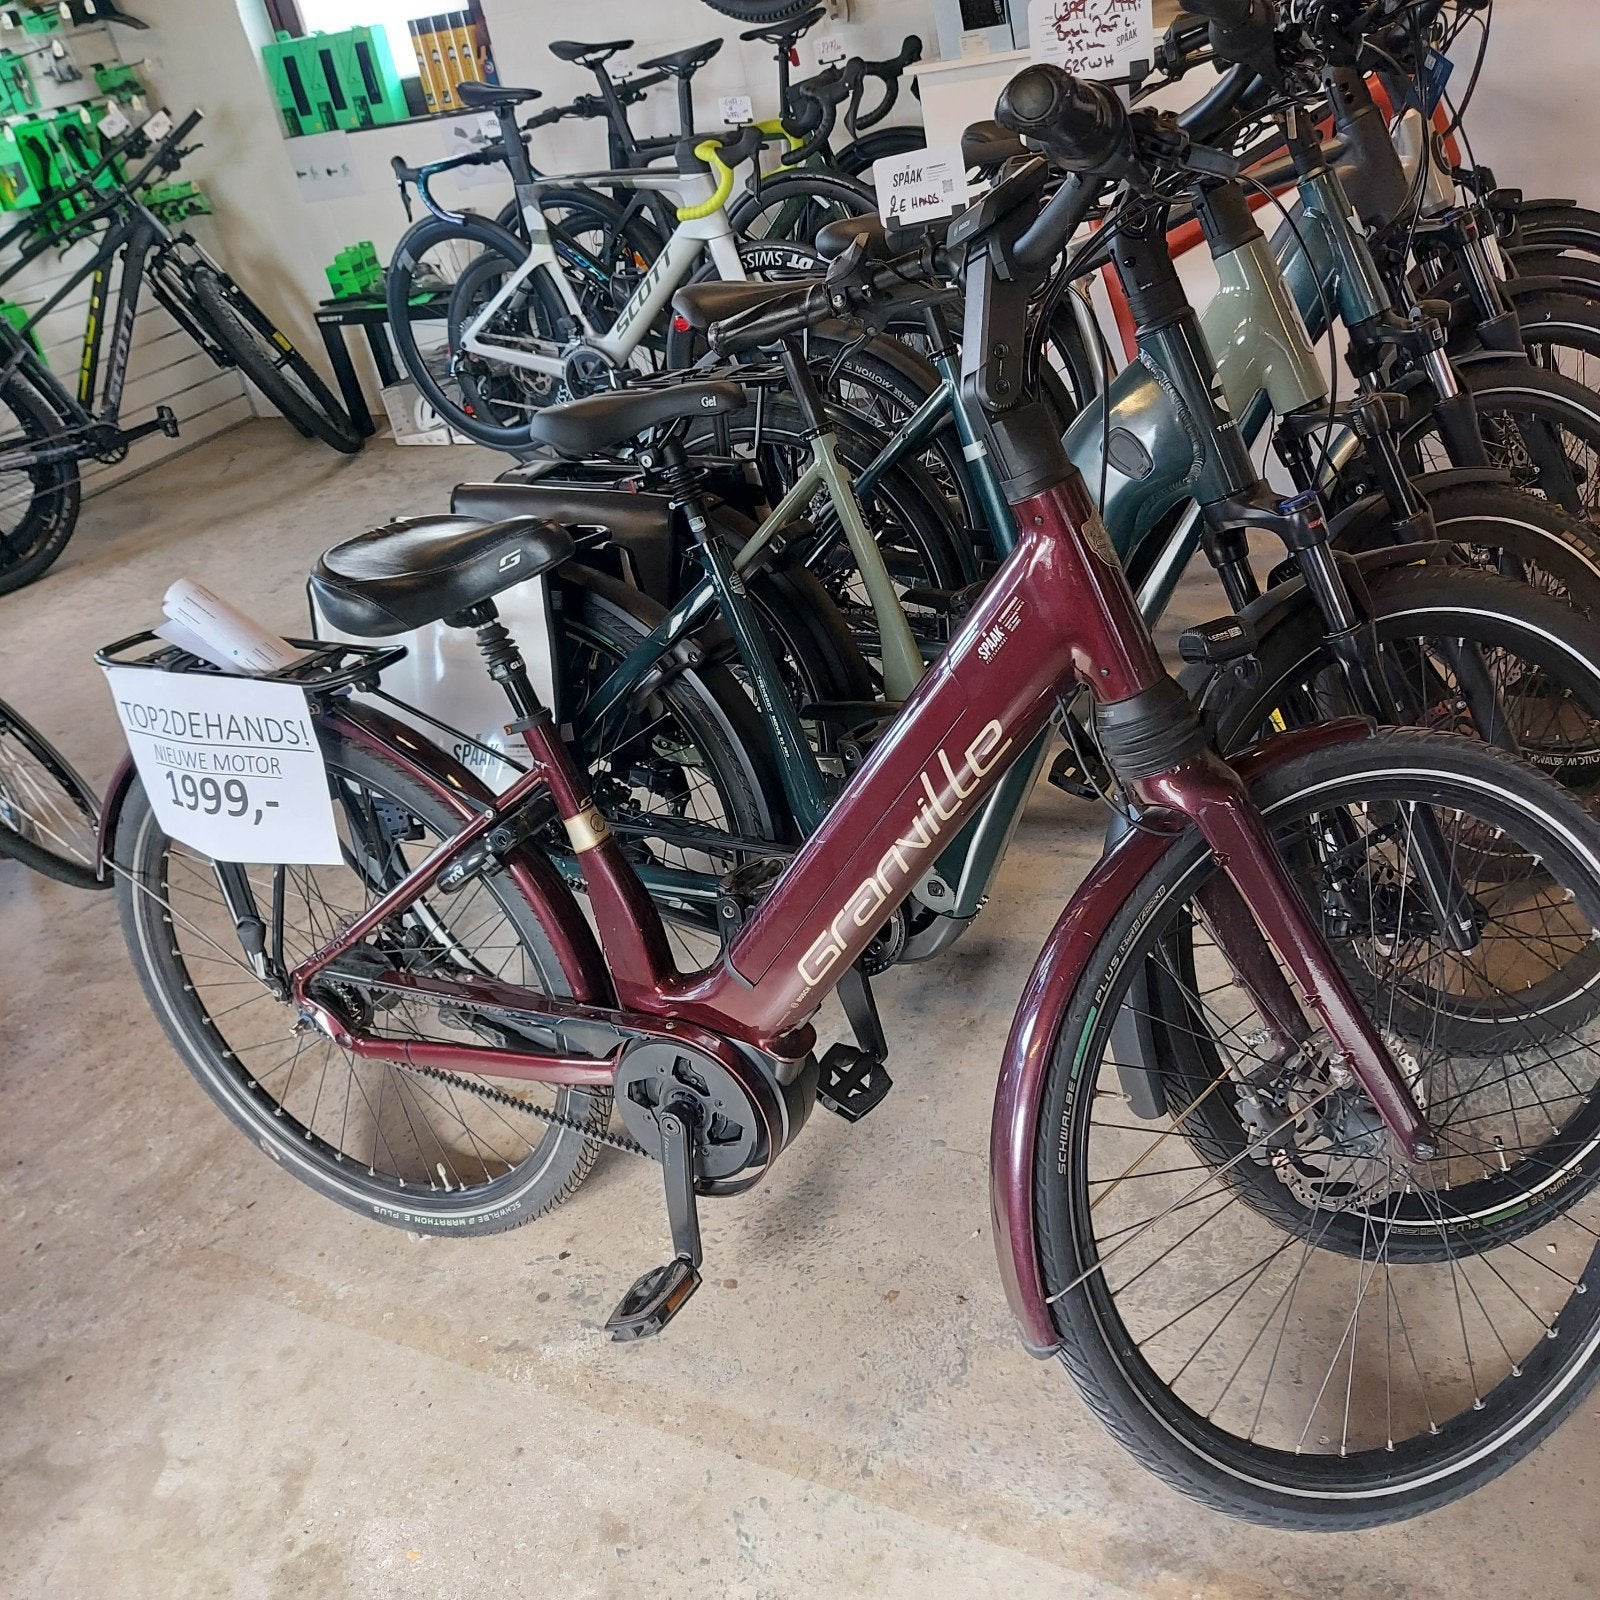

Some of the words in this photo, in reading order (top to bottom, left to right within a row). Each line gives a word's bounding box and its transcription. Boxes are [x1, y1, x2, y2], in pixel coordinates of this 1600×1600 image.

[786, 254, 815, 270] DT
[616, 243, 672, 340] SCOTT
[854, 365, 893, 389] MOTION
[701, 395, 717, 407] Gel
[120, 701, 310, 746] TOP2DEHANDS!
[154, 744, 207, 770] NIEUWE
[213, 754, 282, 775] MOTOR
[165, 770, 280, 826] 1999,-
[1058, 1081, 1076, 1175] SCHWALBE
[1095, 955, 1120, 1003] PLUS
[373, 1206, 399, 1219] PLUS
[414, 1216, 466, 1227] MARATHON
[478, 1200, 522, 1223] SCHWALBE
